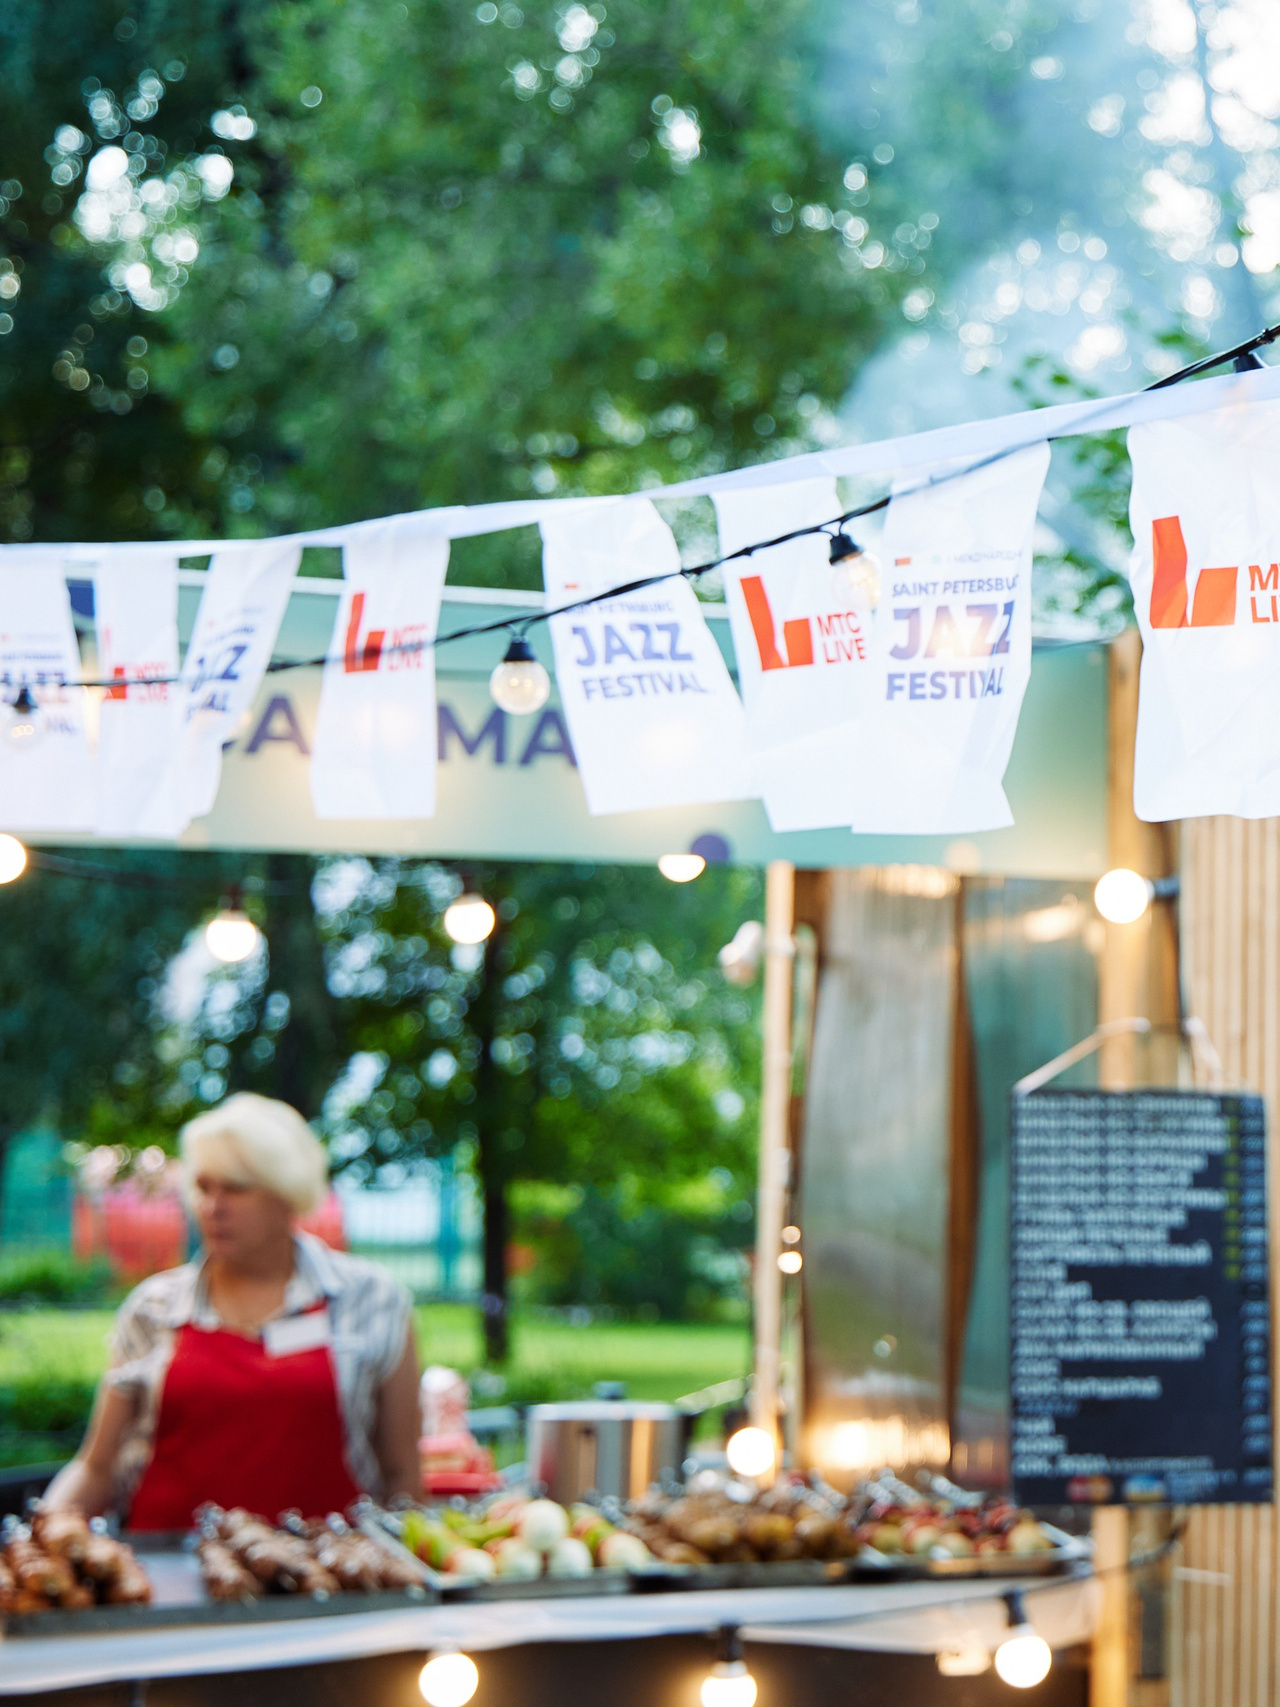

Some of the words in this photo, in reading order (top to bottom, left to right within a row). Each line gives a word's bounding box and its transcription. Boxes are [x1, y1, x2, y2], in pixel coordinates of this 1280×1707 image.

[892, 581, 939, 598] SAINT
[572, 622, 694, 667] JAZZ
[888, 600, 1016, 661] JAZZ
[822, 638, 867, 664] LIVE
[582, 672, 709, 701] FESTIVAL
[886, 667, 1004, 701] FESTIVAL
